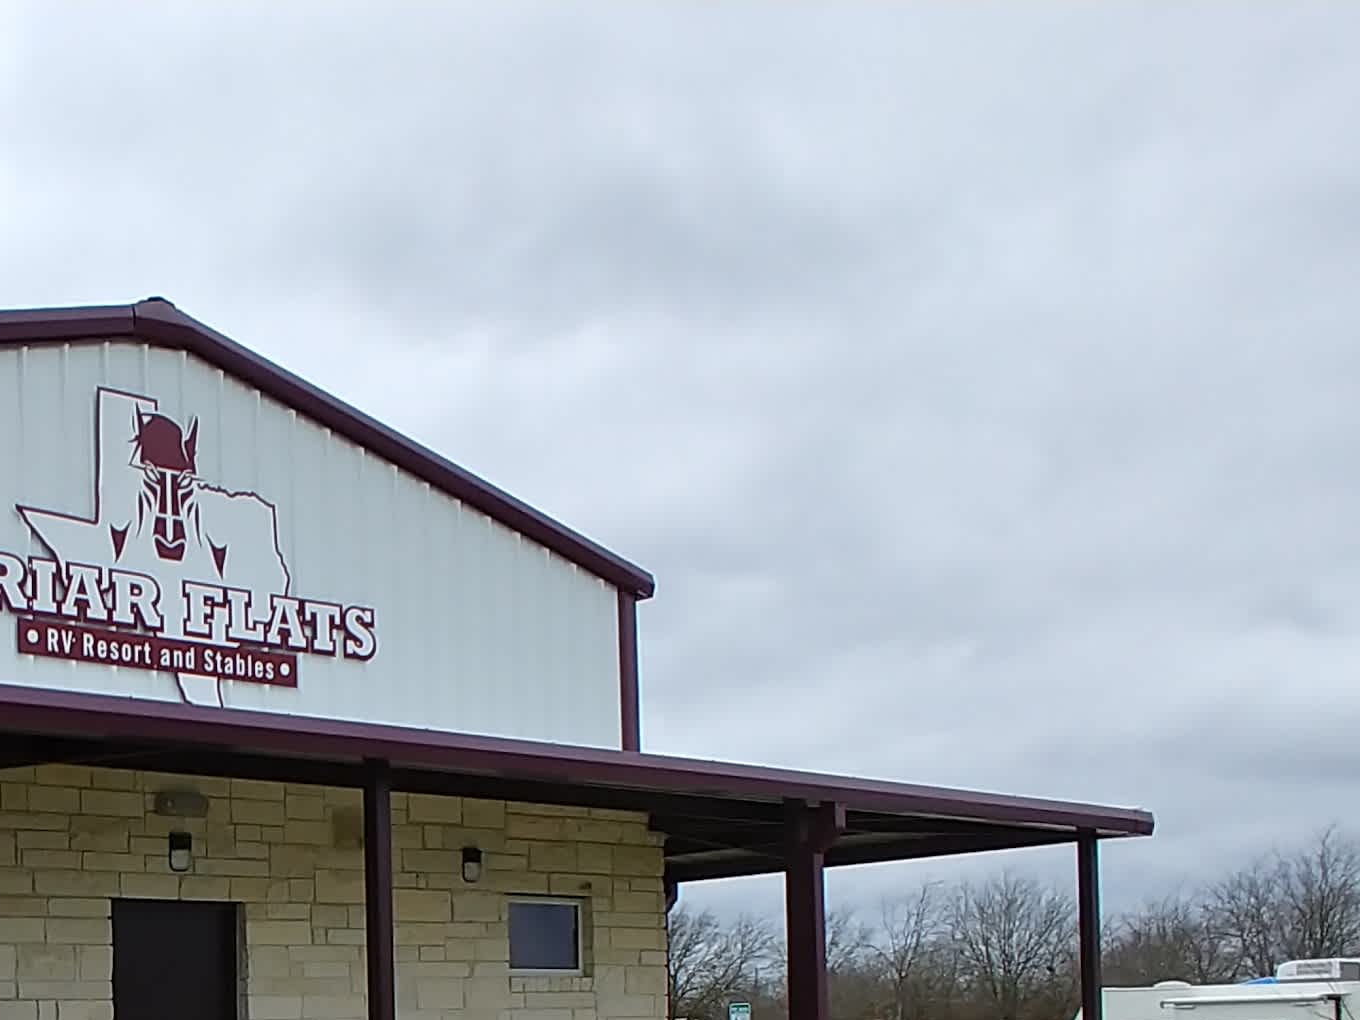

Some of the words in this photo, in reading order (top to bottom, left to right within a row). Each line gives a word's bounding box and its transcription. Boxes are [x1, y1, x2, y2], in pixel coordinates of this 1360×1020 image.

[46, 627, 74, 654] RV
[82, 632, 151, 664] Resort
[160, 647, 196, 670] and
[203, 649, 274, 680] Stables
[182, 580, 377, 662] FLATS
